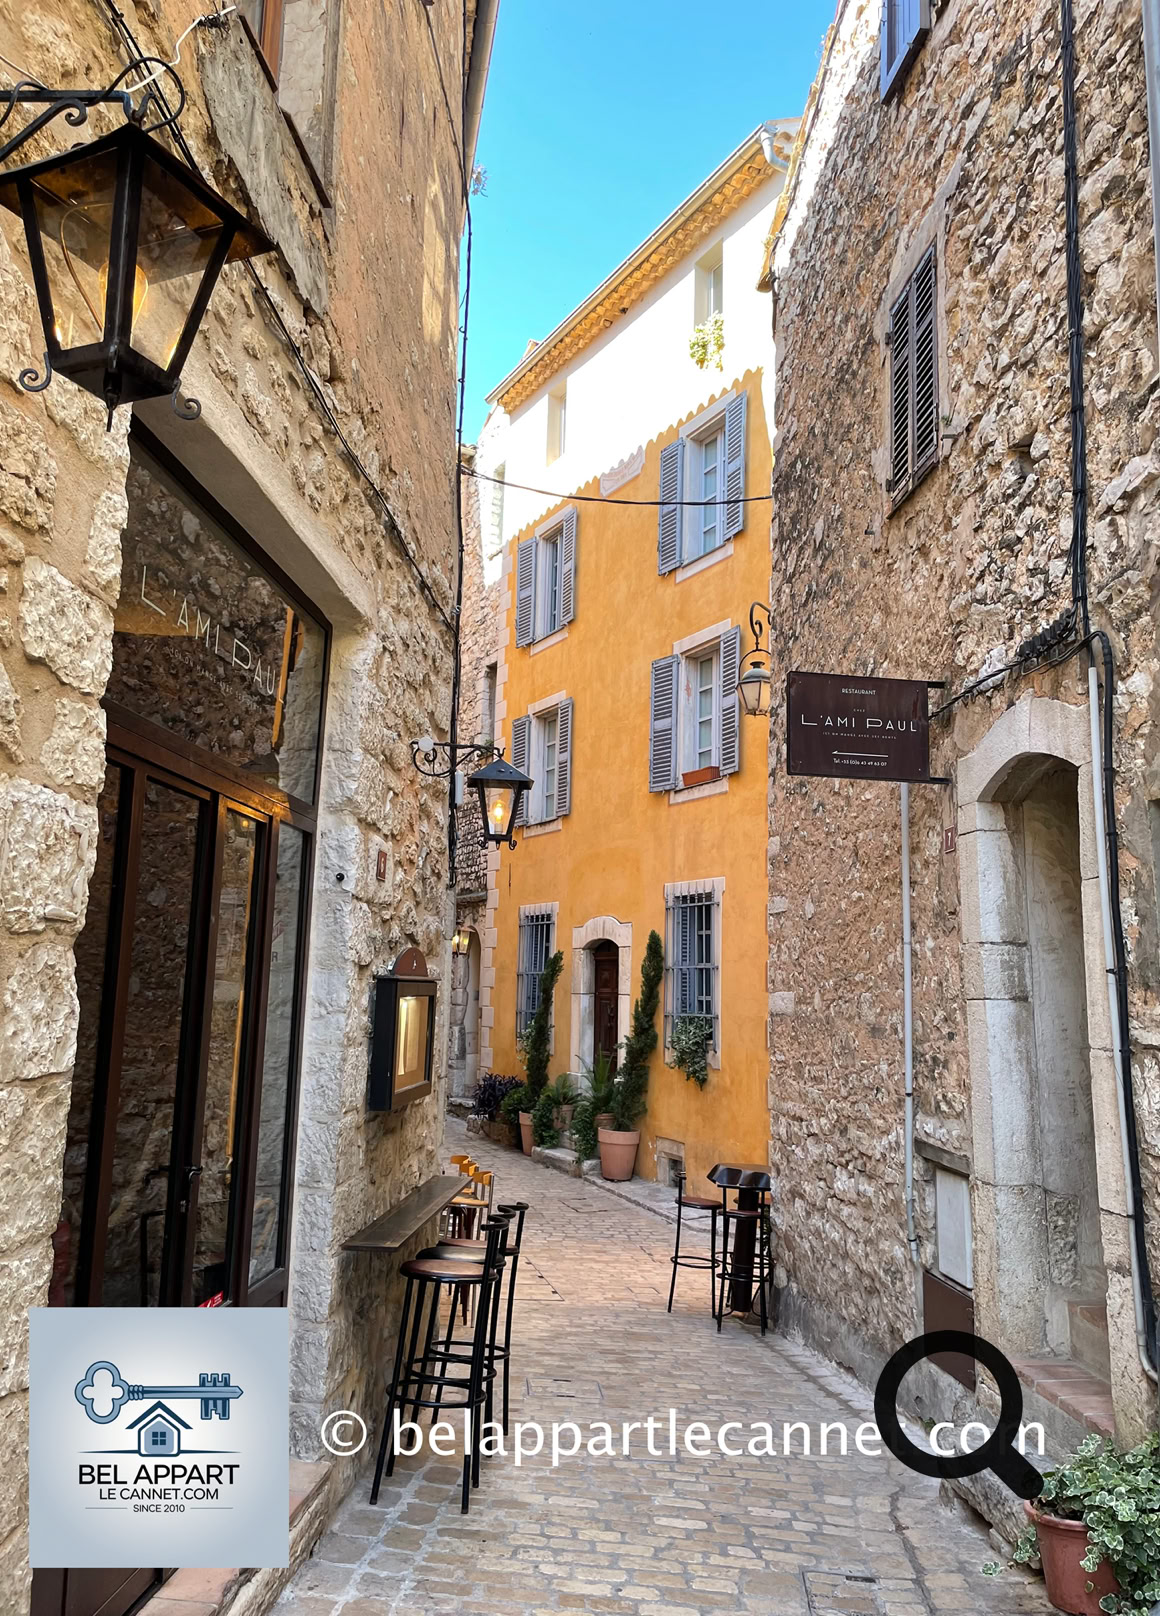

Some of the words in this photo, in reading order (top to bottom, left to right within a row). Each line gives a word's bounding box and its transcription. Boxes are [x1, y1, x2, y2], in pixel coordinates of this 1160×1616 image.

[141, 565, 220, 654] L'AMI
[231, 638, 284, 704] PAUL
[841, 687, 877, 695] RESTAURANT
[801, 713, 856, 728] L'AMI
[866, 718, 917, 732] PAUL
